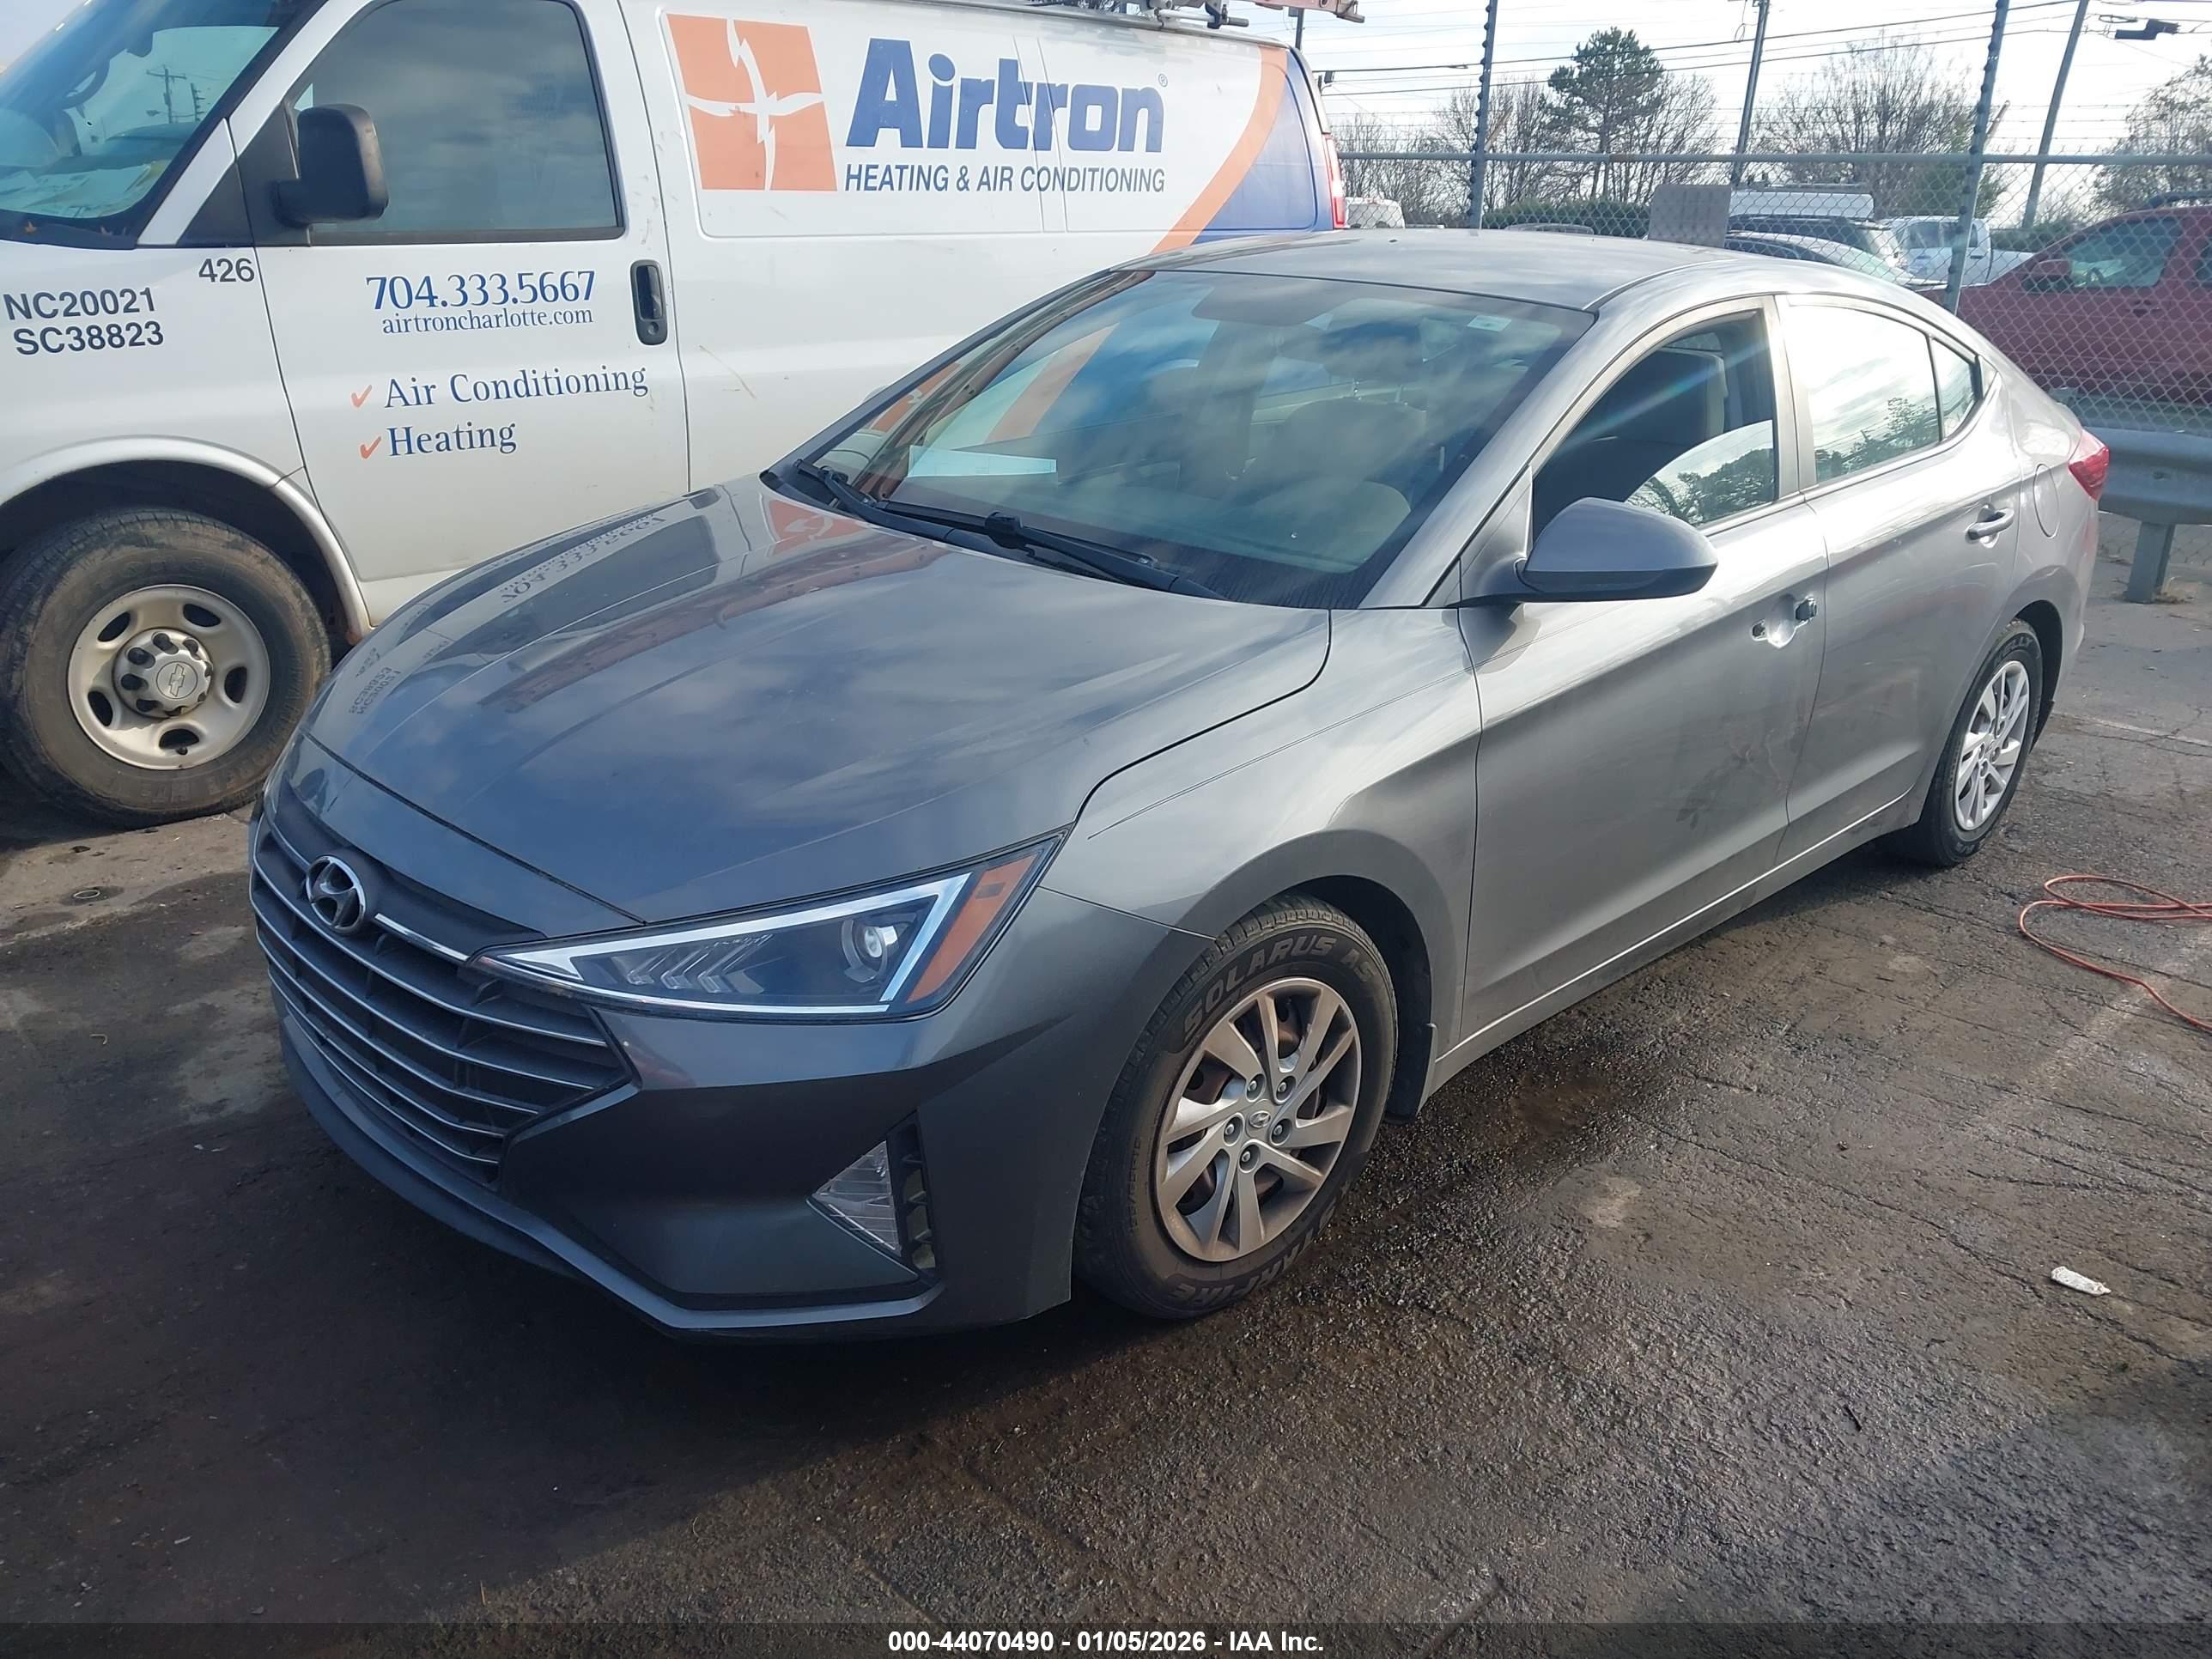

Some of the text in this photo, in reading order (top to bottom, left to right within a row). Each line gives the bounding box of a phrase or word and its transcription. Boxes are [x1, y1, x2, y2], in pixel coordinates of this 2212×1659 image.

[845, 37, 1164, 153] Airtron
[845, 163, 1165, 193] HEATING & AIR CONDITIONING
[198, 258, 255, 283] 426
[3, 286, 156, 320] NC20021
[366, 270, 595, 310] 704.333.5667
[13, 320, 164, 356] SC38823
[381, 306, 593, 334] airtroncharlotte.com
[384, 365, 649, 409] Air Conditioning
[386, 421, 517, 457] Heating
[1183, 934, 1376, 1042] SOLARUS AS
